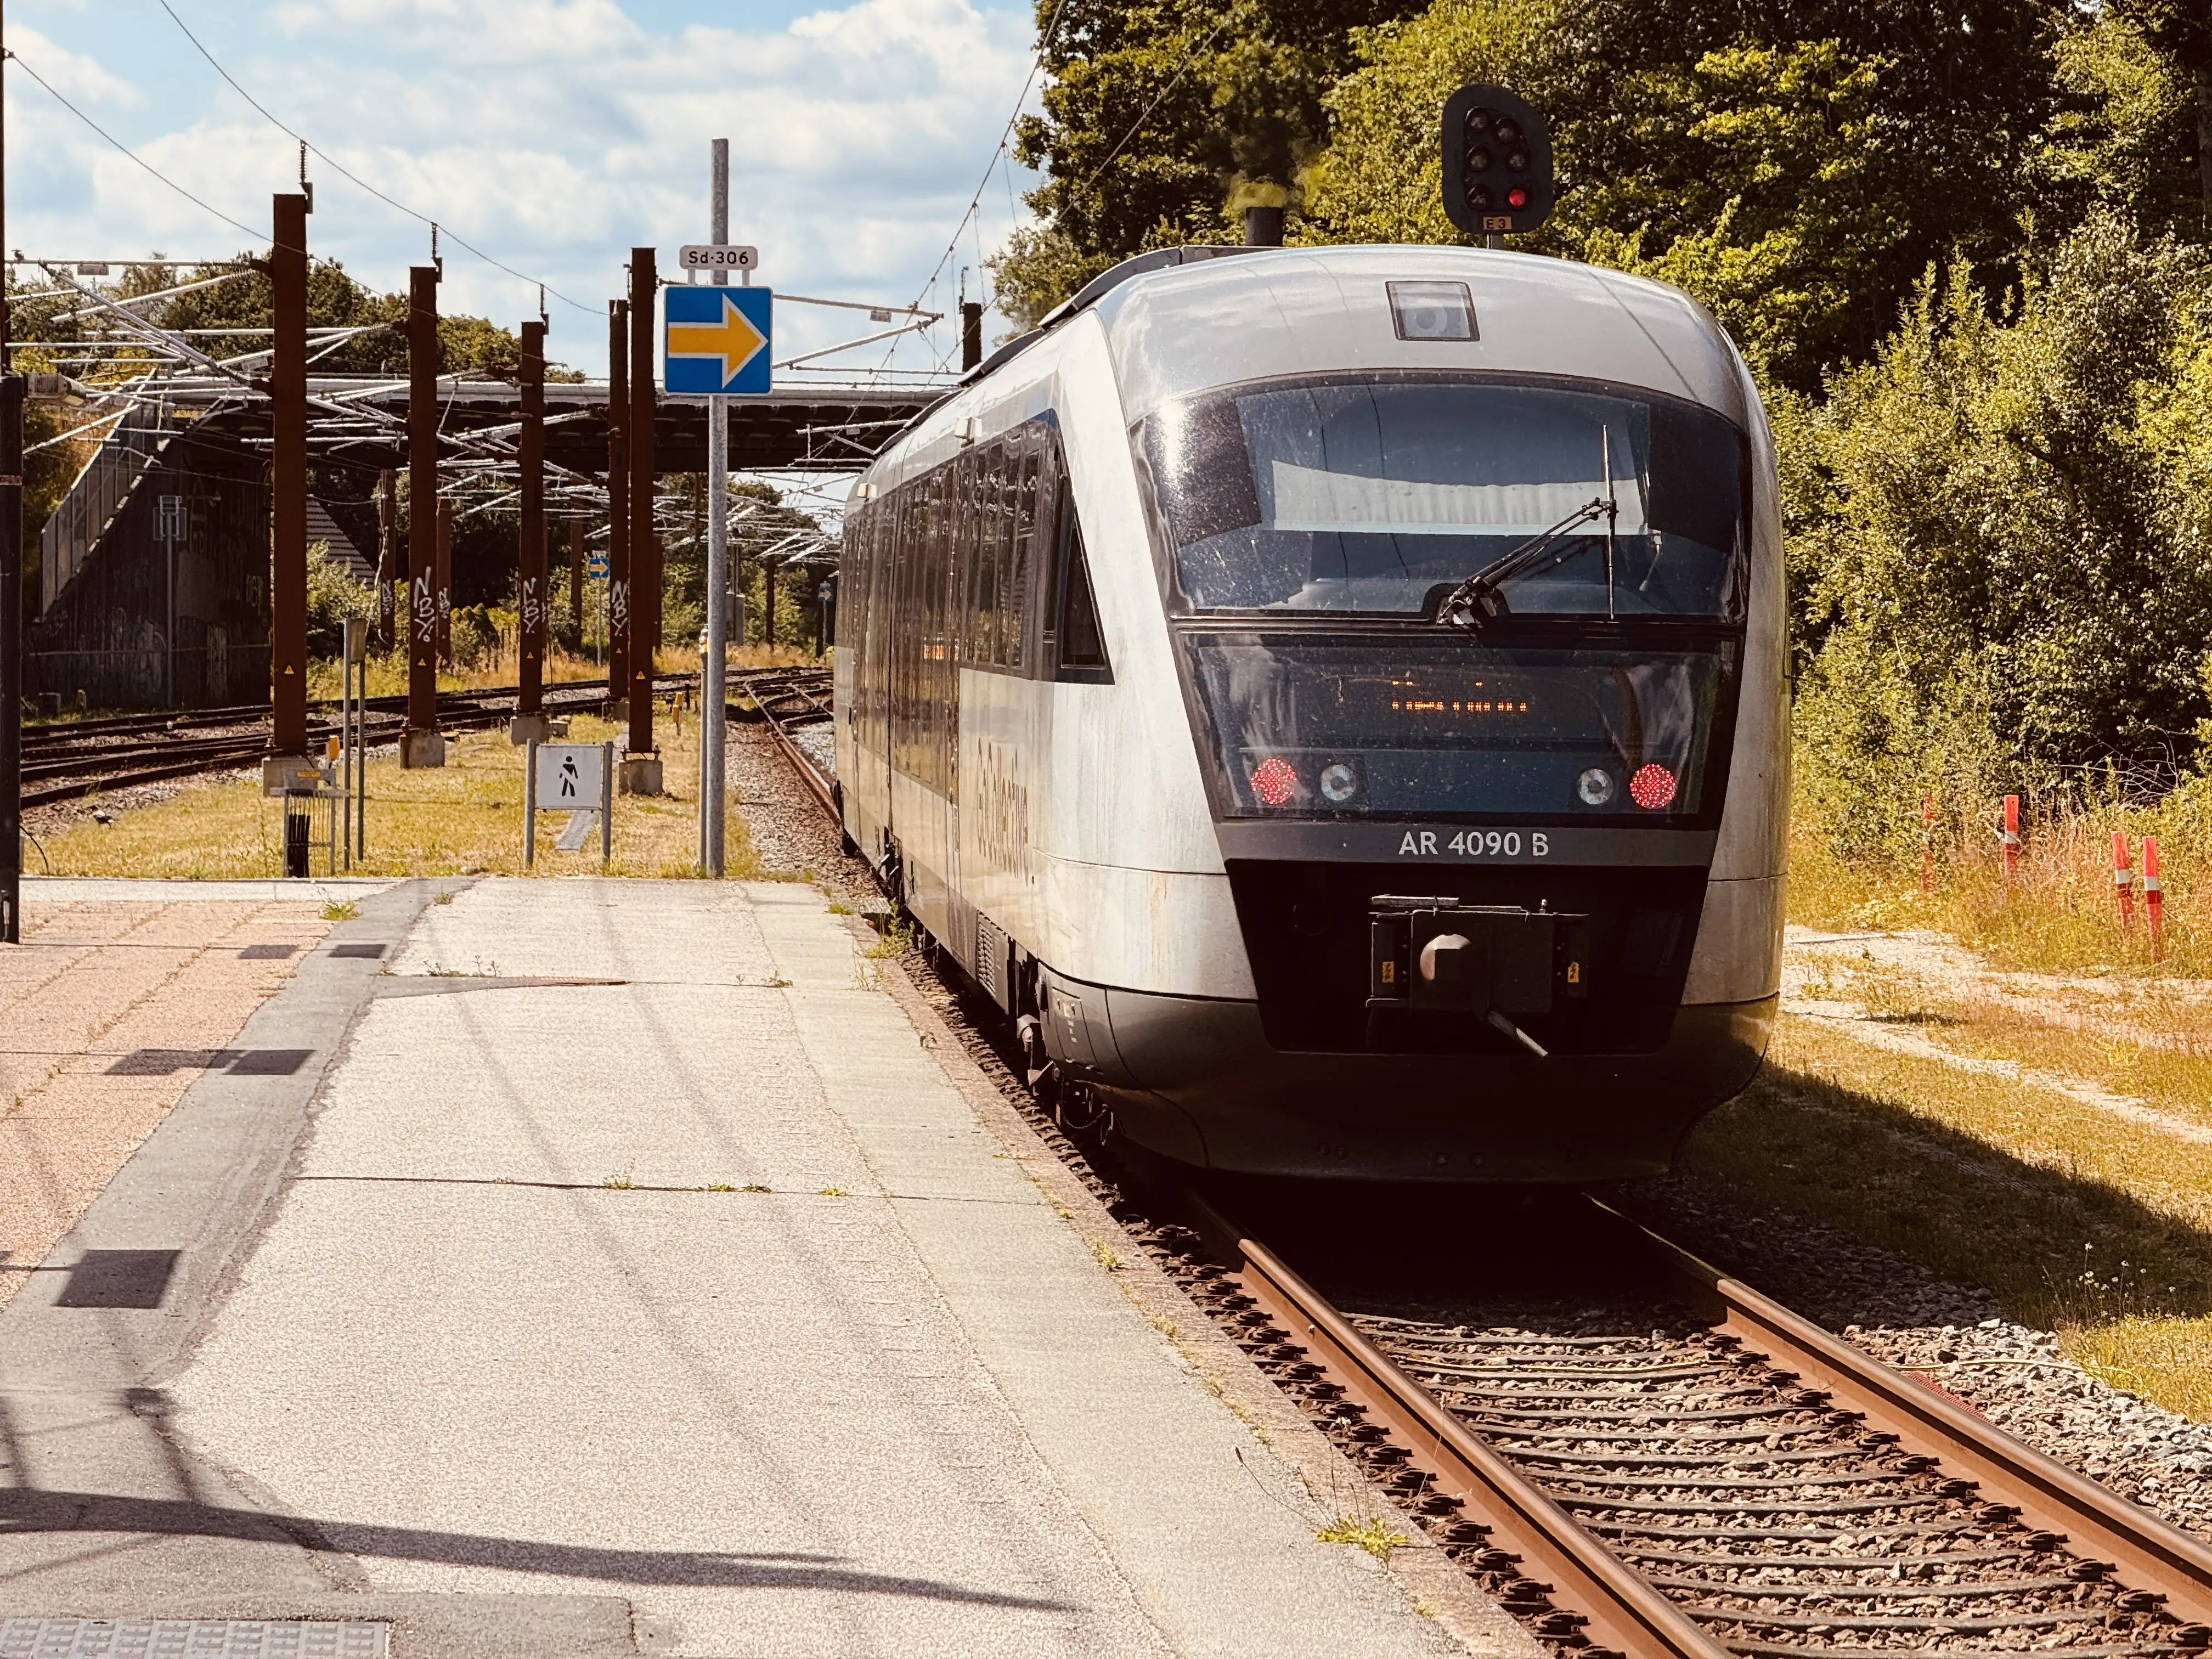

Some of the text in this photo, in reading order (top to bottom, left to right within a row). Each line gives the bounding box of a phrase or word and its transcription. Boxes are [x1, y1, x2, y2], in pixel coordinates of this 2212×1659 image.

[689, 251, 749, 264] Sd-306
[1399, 831, 1549, 856] AR 4090 B
